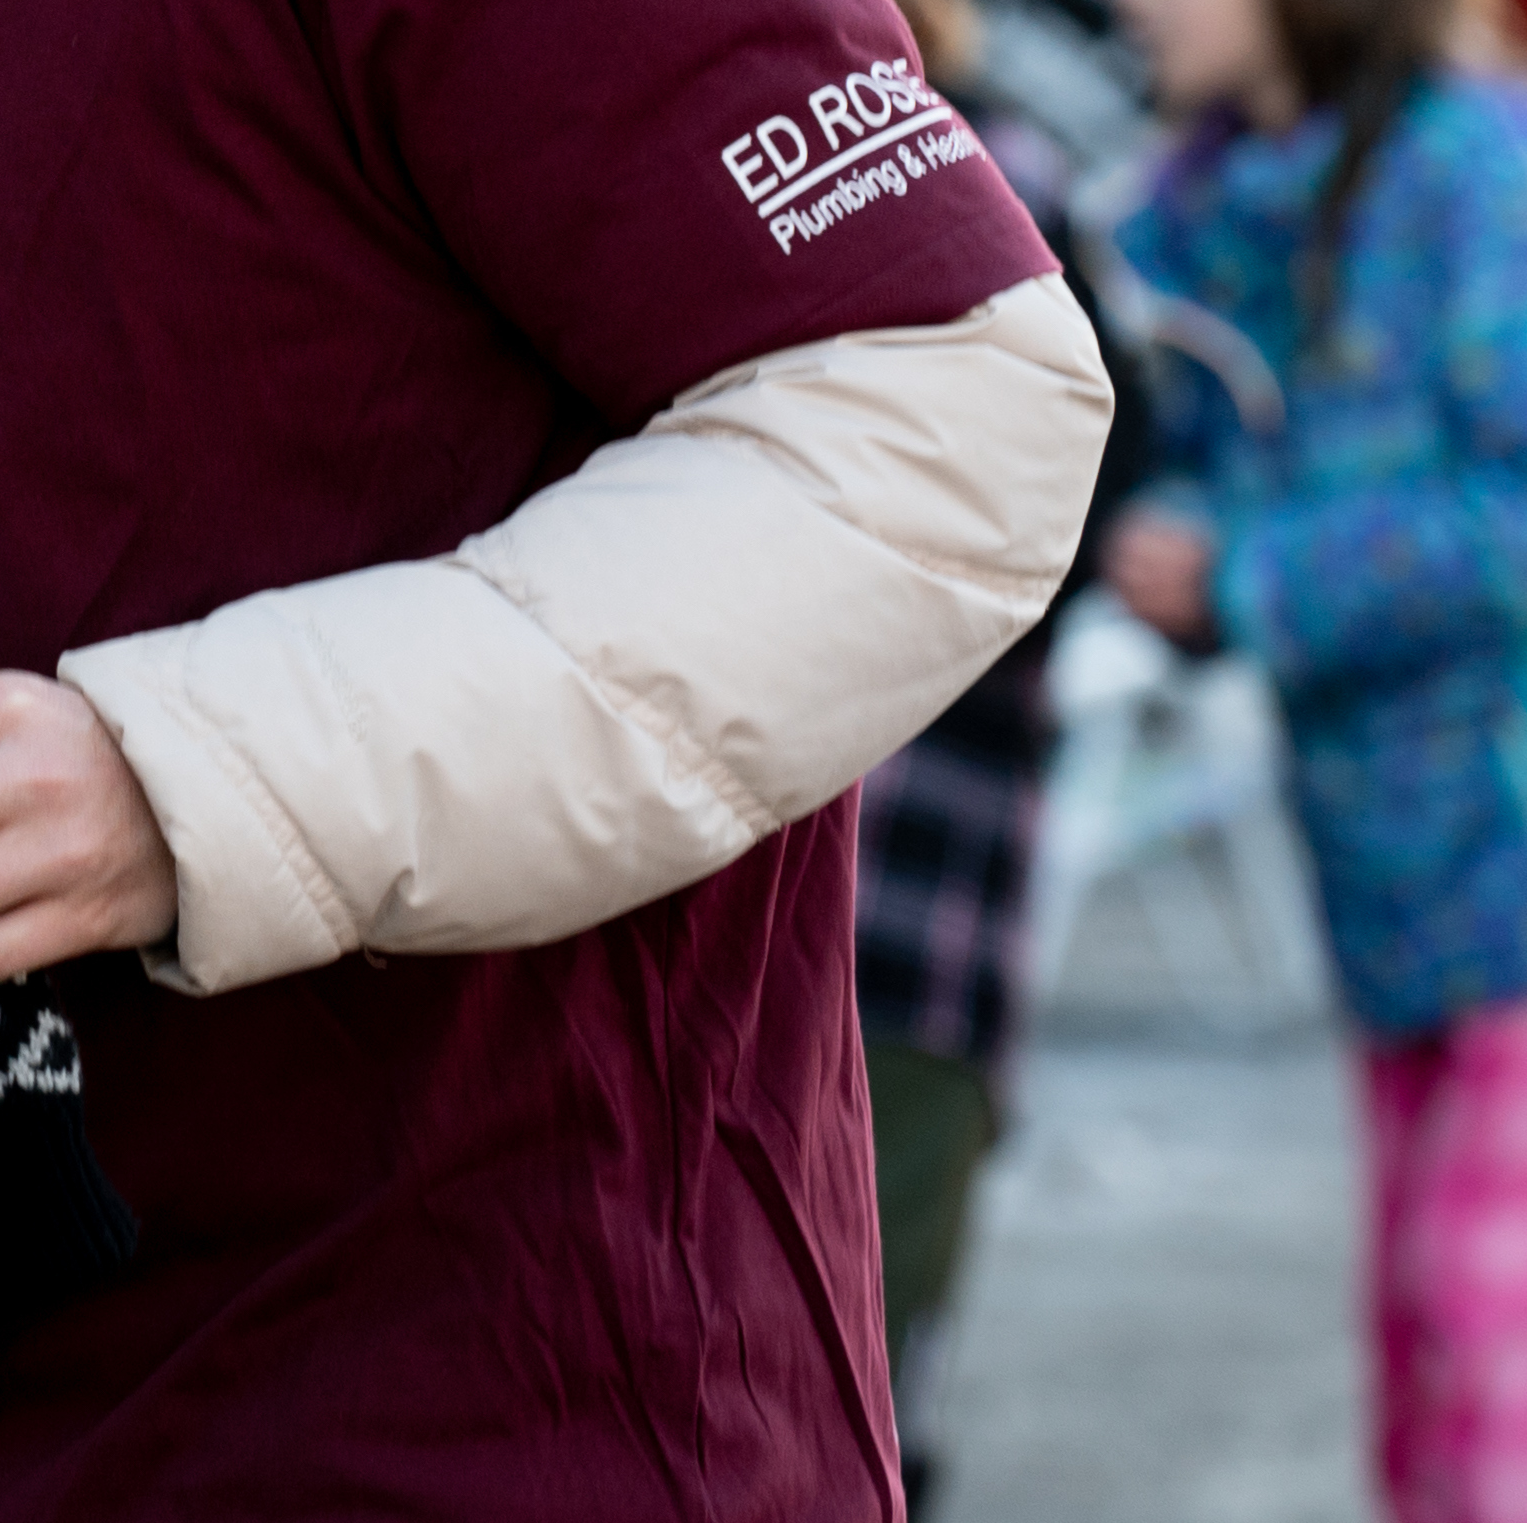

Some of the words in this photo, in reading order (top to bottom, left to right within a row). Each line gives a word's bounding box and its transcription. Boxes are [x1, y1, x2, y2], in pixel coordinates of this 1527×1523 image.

[721, 114, 808, 204] ED
[769, 158, 908, 257] Plumbing
[896, 143, 927, 179] &
